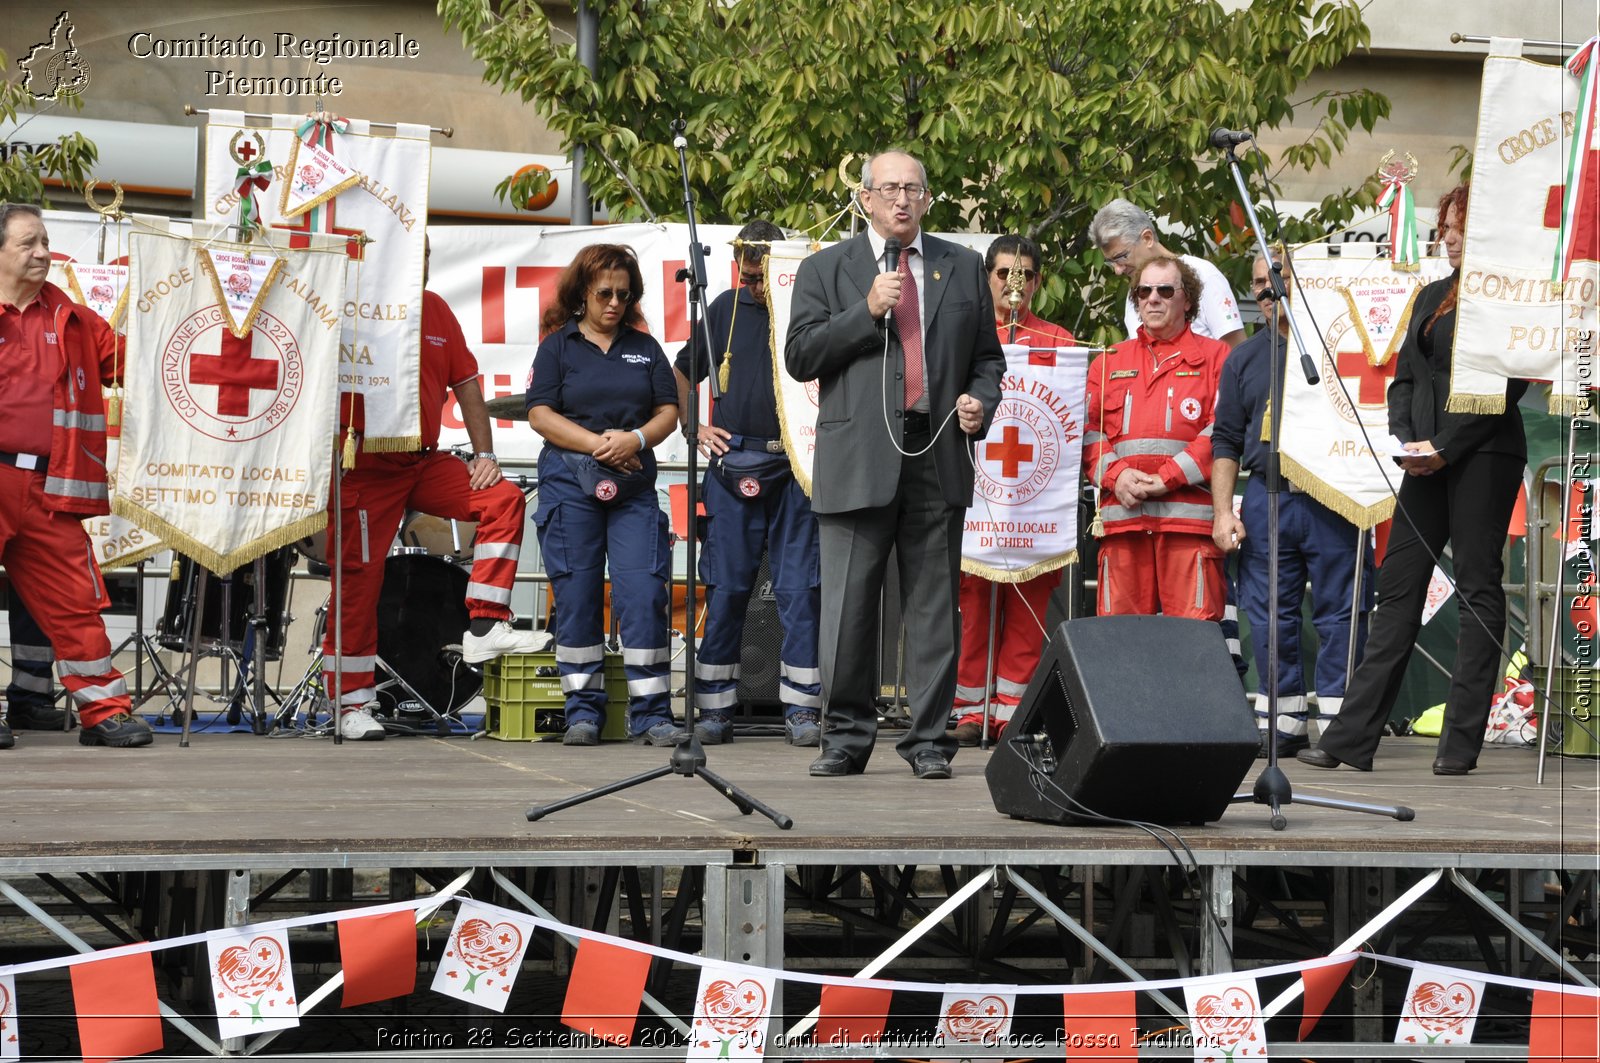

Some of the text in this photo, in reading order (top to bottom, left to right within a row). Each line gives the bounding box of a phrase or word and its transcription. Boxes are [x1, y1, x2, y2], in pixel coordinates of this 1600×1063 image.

[1498, 117, 1557, 165] CROCE
[359, 173, 417, 233] ALIANA
[1295, 276, 1342, 290] CROCE
[136, 267, 193, 313] CROCE
[277, 270, 339, 331] TALIANA
[343, 301, 408, 320] OCALE
[193, 313, 210, 328] DI
[1334, 320, 1347, 334] DI
[269, 324, 287, 341] 22
[165, 322, 198, 419] CONVENZIONE
[281, 340, 300, 399] AGOSTO
[368, 376, 390, 387] 1974
[266, 399, 290, 425] 1864
[1030, 380, 1079, 444] ITALIANA
[1038, 425, 1053, 439] 22
[146, 462, 306, 482] COMITATO LOCALE
[1033, 440, 1056, 485] AGOSTO
[131, 486, 317, 509] SETTIMO TORINESE
[1015, 482, 1036, 501] 1864
[1017, 521, 1057, 534] LOCALE
[980, 536, 1034, 549] DI CHIERI
